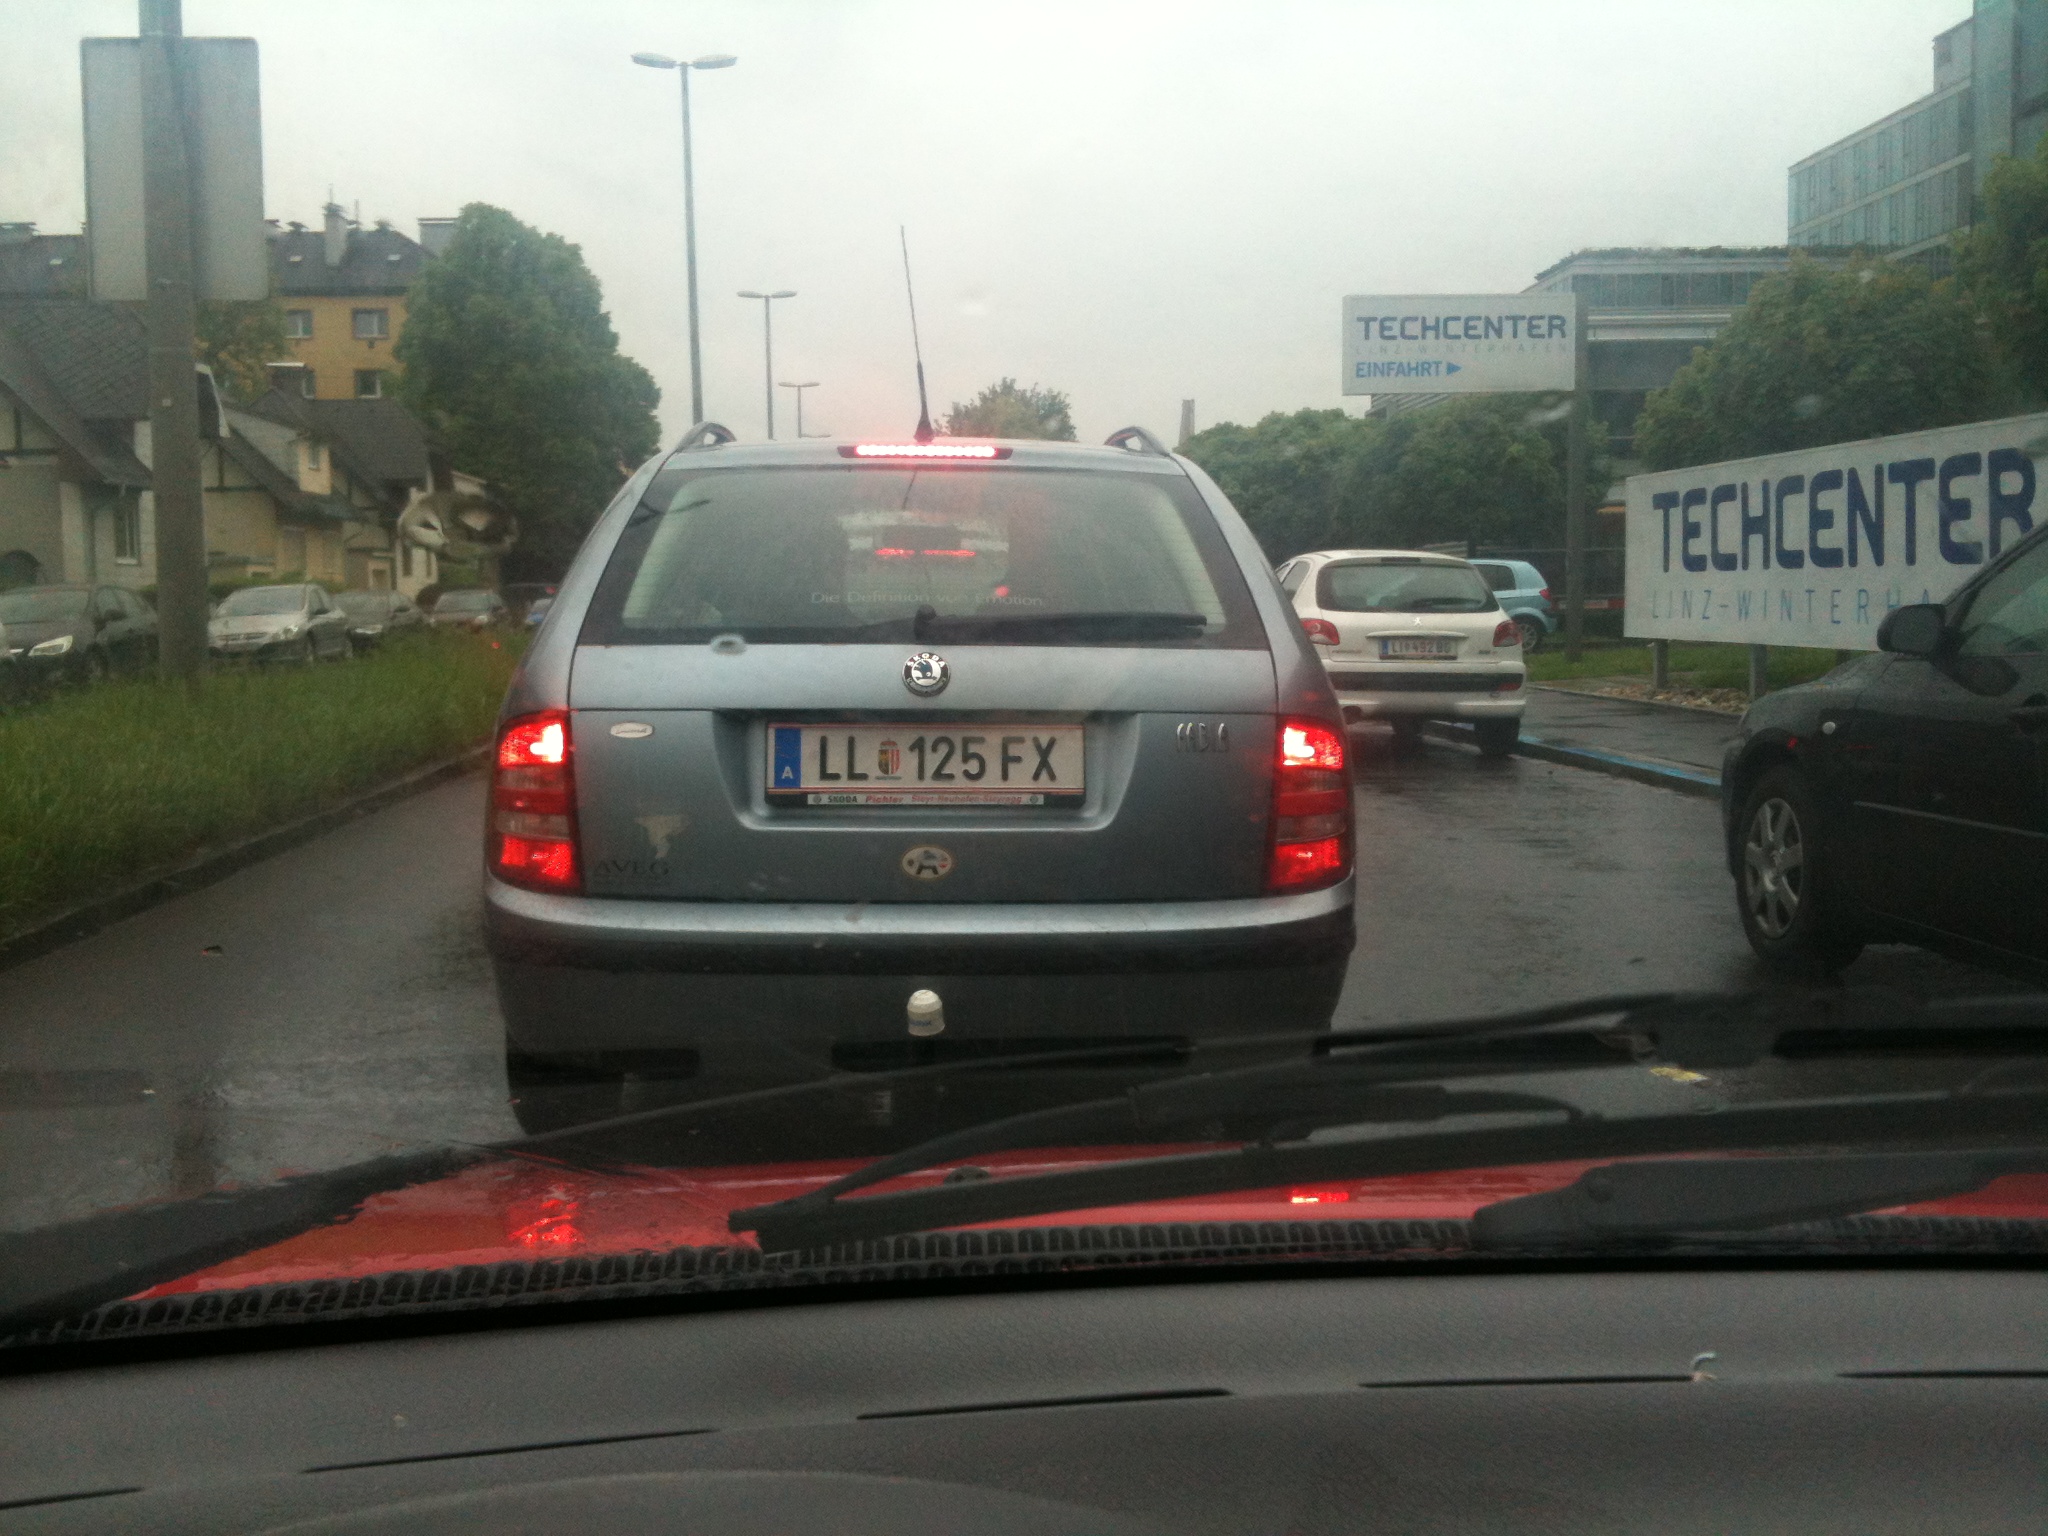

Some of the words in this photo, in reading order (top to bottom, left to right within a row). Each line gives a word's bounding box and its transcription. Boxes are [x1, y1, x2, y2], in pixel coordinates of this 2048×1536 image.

[1356, 314, 1567, 341] TECHCENTER
[1355, 361, 1443, 378] EINFAHRT
[1651, 447, 2037, 573] TECHCENTER
[819, 735, 869, 781] LL
[908, 736, 986, 781] 125
[1001, 736, 1057, 781] FX
[781, 766, 794, 779] A
